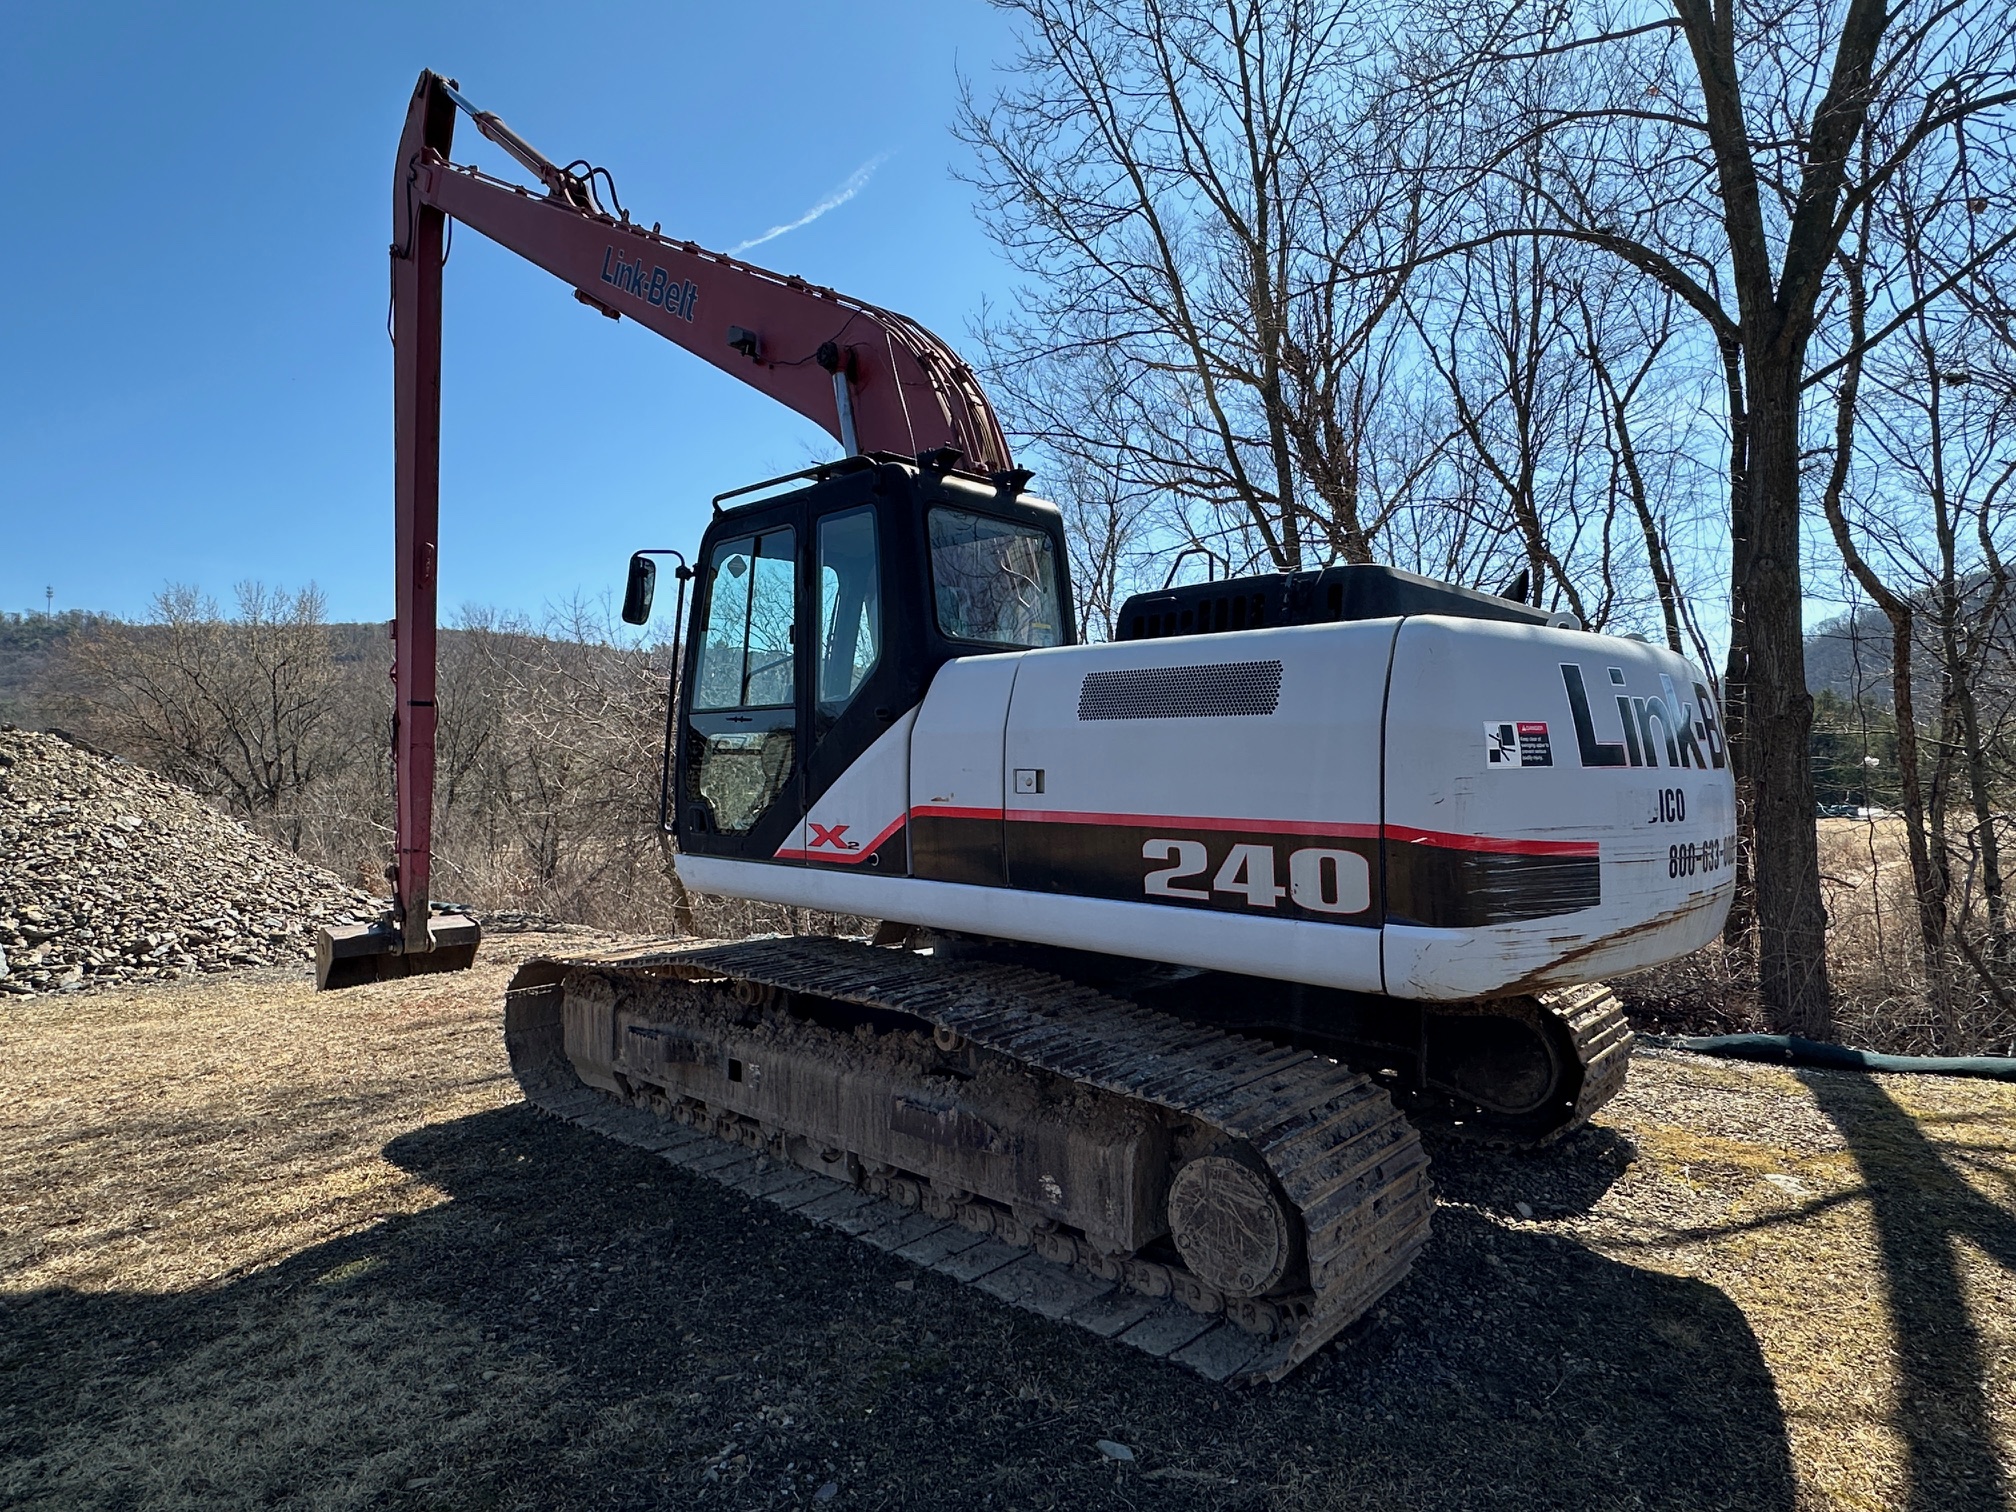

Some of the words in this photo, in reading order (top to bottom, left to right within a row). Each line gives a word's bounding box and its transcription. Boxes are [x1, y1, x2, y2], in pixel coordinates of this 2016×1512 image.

[600, 245, 698, 323] Link-Belt
[1559, 663, 1729, 769] Link-B
[1648, 788, 1685, 823] ICO
[1142, 838, 1370, 914] 240
[1669, 835, 1736, 878] 800-633-
